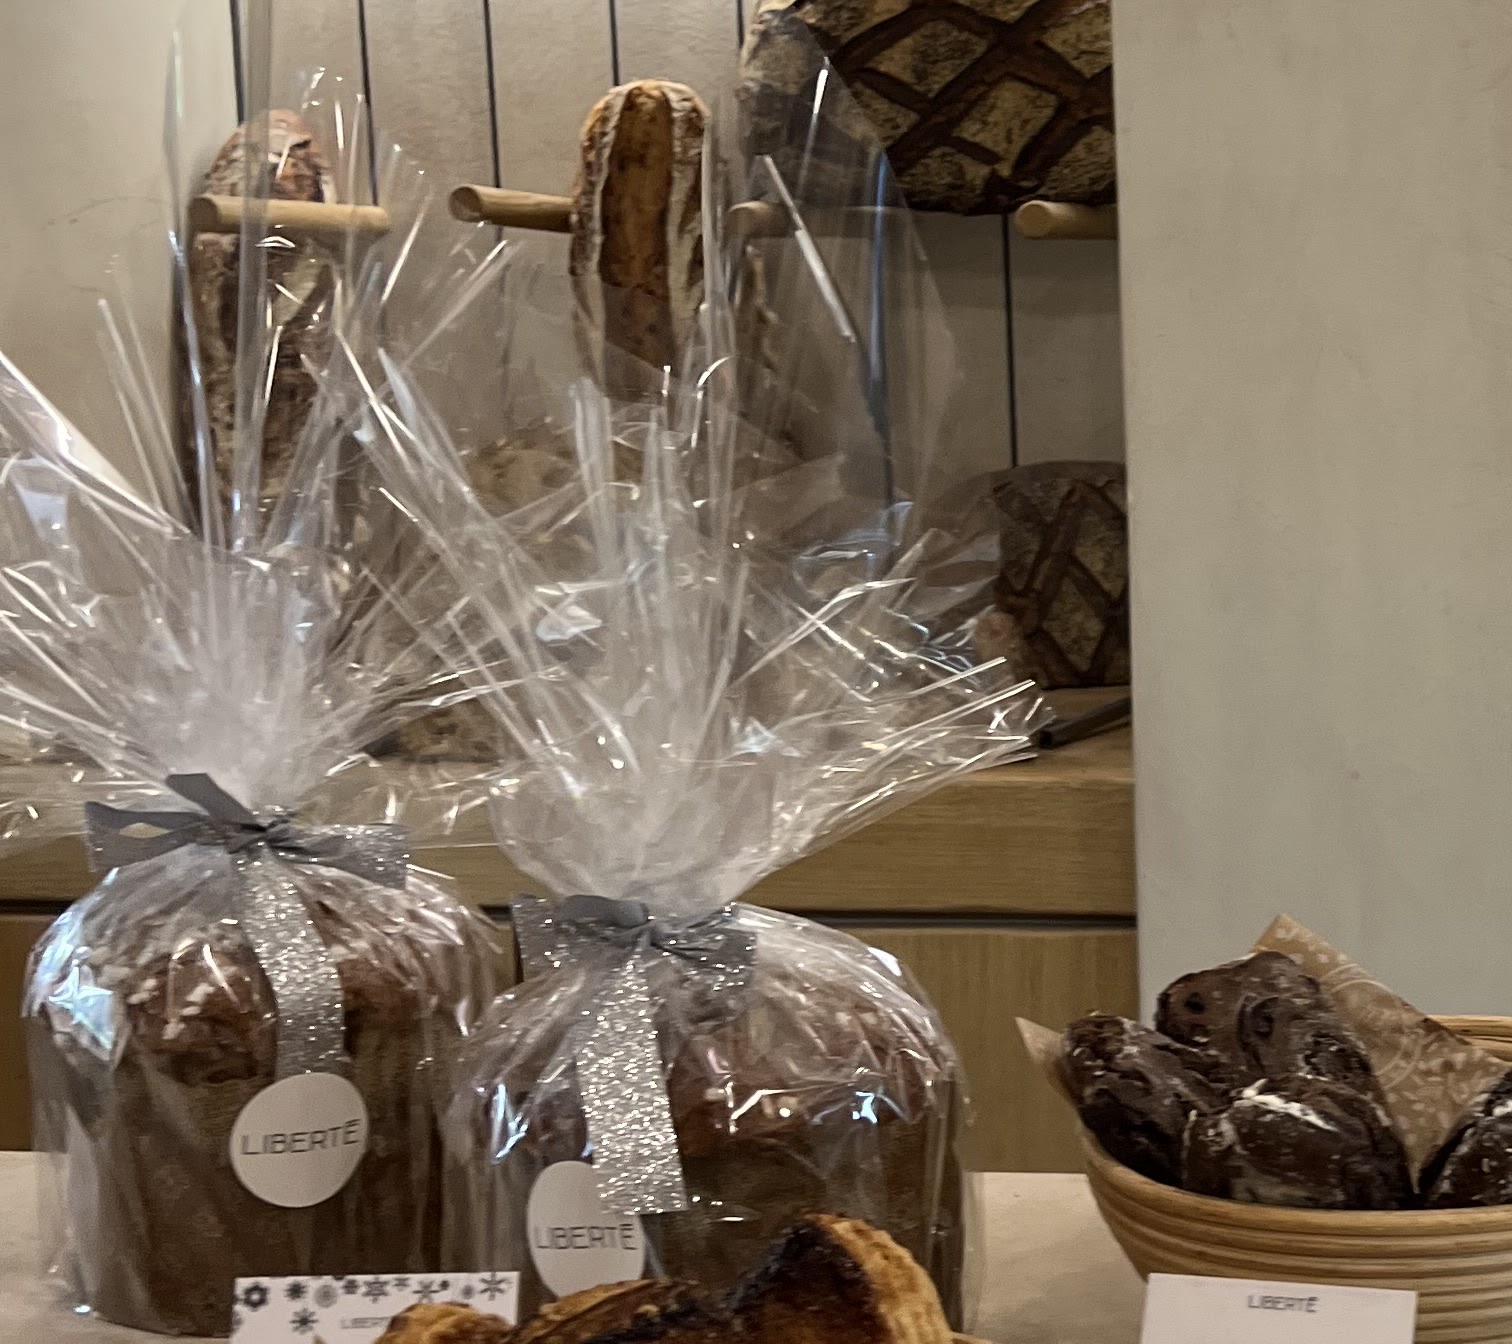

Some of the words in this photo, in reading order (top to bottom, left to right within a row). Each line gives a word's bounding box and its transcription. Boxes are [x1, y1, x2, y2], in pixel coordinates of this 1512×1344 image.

[241, 1118, 361, 1155] LIBERTÉ
[535, 1223, 639, 1250] LIBERTÉ
[1248, 1295, 1319, 1313] LIBERTÉ
